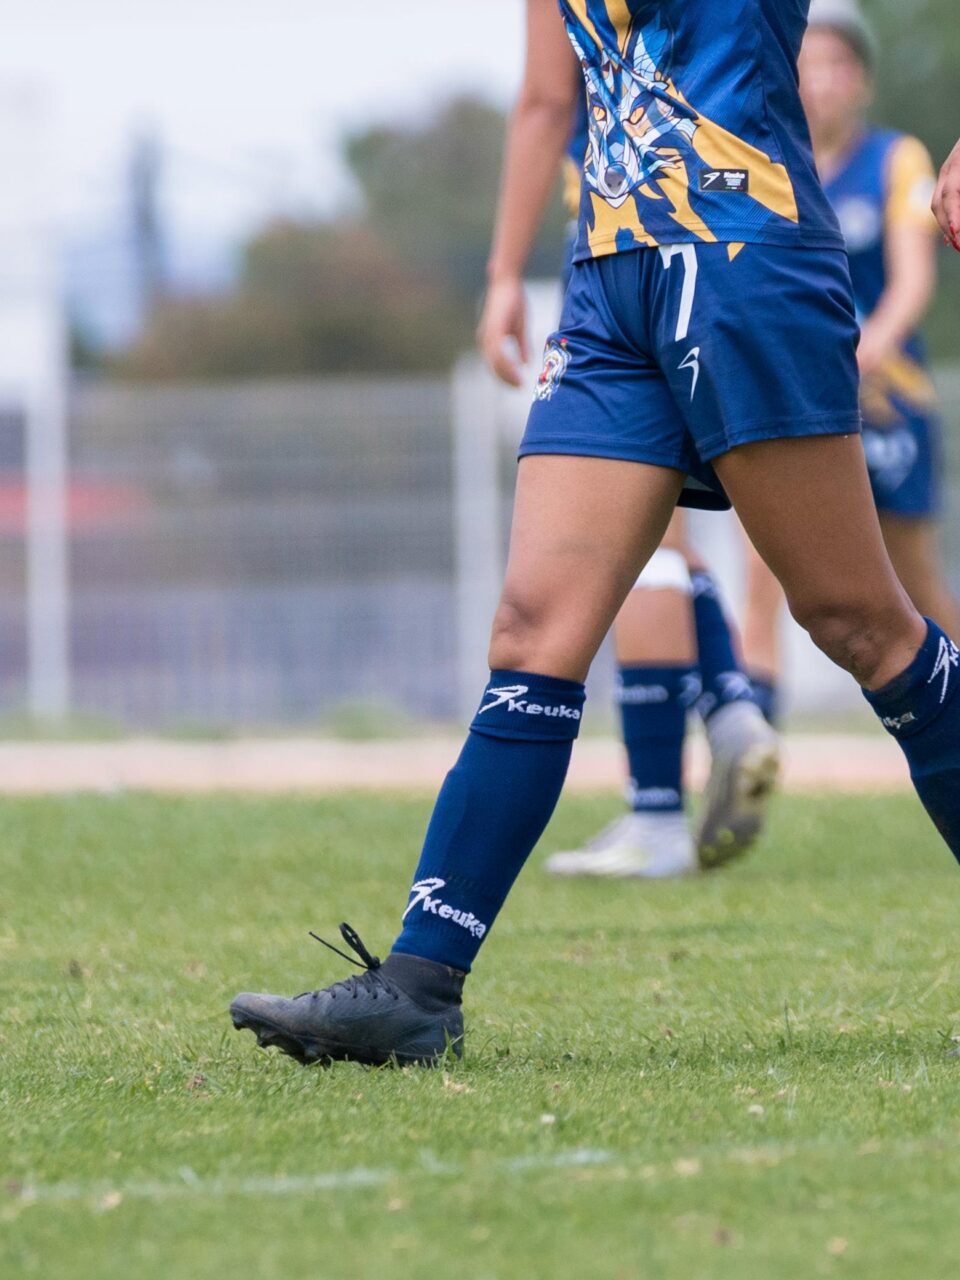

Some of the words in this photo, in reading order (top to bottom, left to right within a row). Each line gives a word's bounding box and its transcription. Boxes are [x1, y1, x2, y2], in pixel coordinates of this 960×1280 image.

[658, 243, 698, 342] 7
[507, 699, 581, 719] Keuka
[422, 895, 487, 939] Keuka
